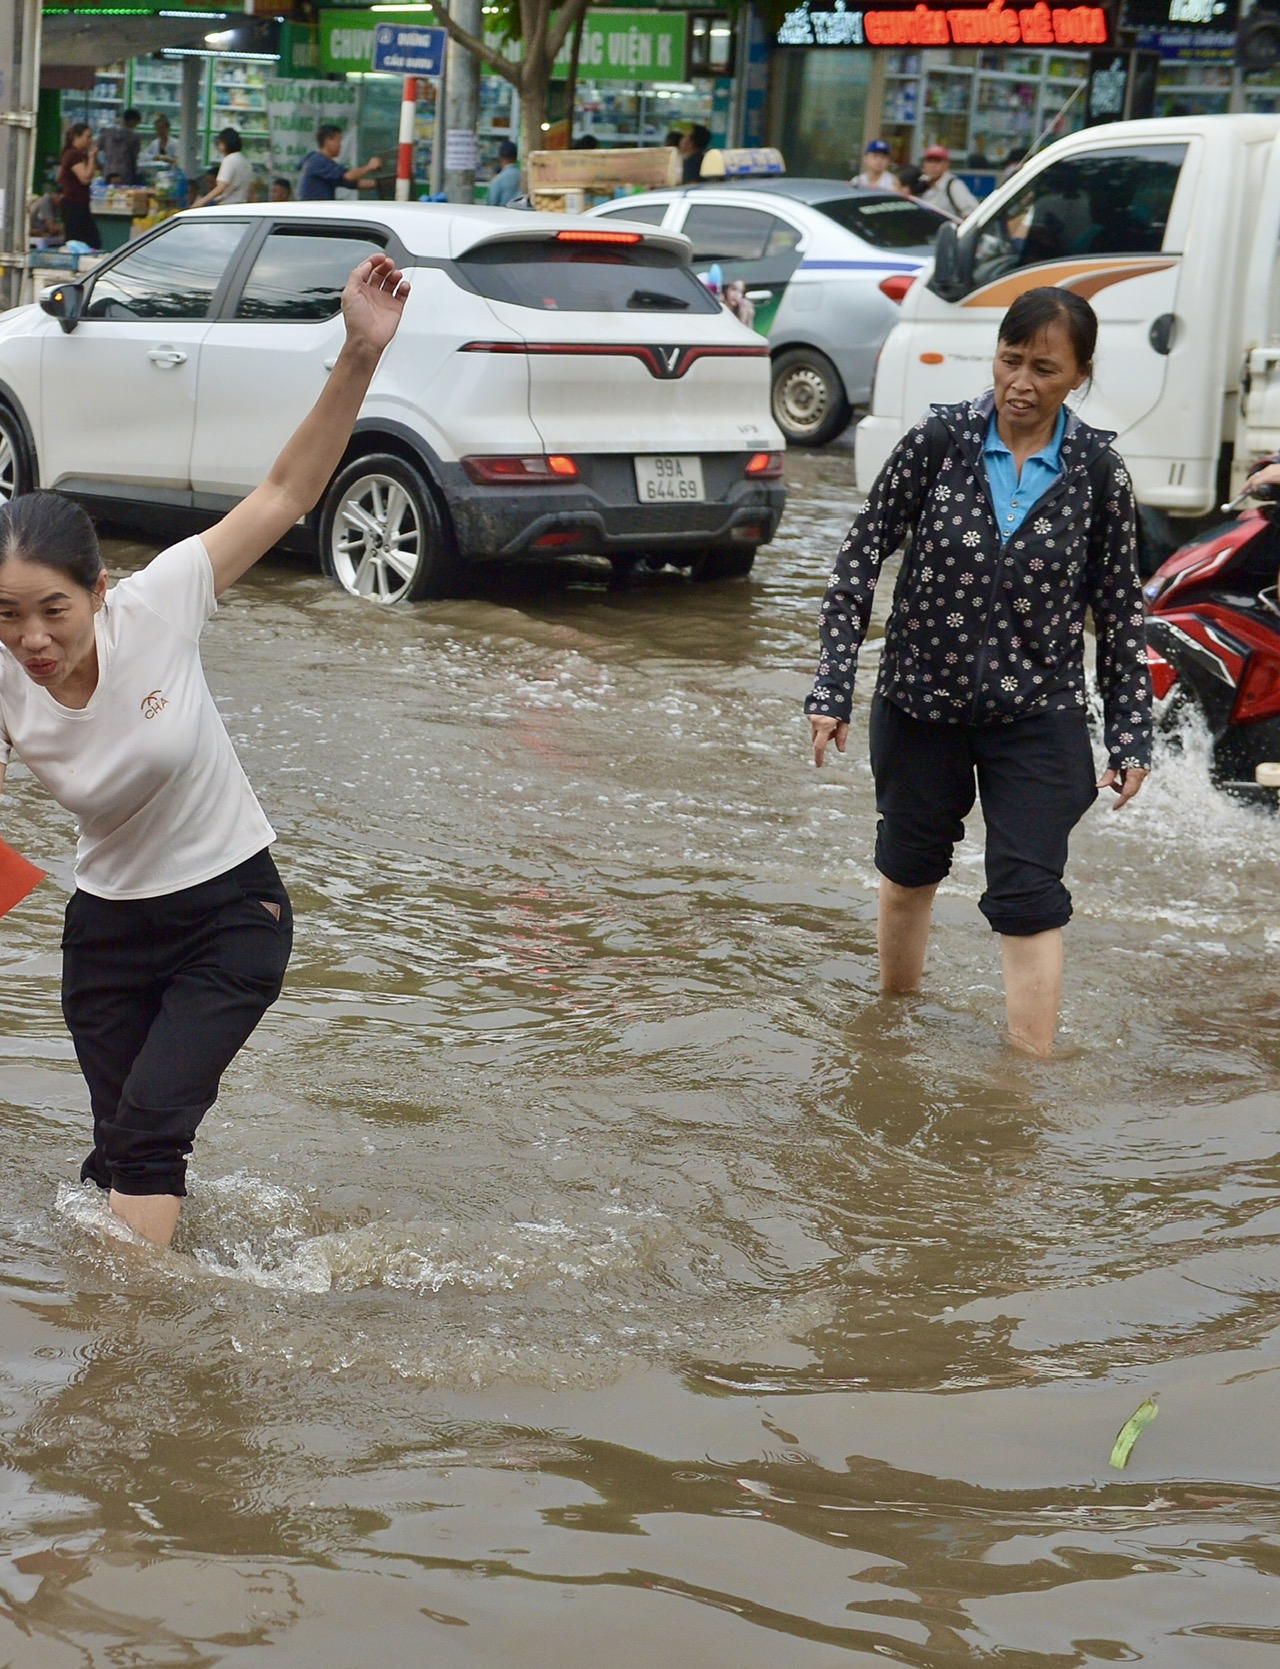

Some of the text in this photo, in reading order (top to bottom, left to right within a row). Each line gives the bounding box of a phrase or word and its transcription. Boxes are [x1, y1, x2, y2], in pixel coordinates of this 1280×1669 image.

[946, 0, 1021, 44] THUỐC
[608, 26, 652, 74] VIỆN
[657, 33, 672, 67] K
[654, 458, 684, 478] 99A
[646, 480, 698, 499] 644.69
